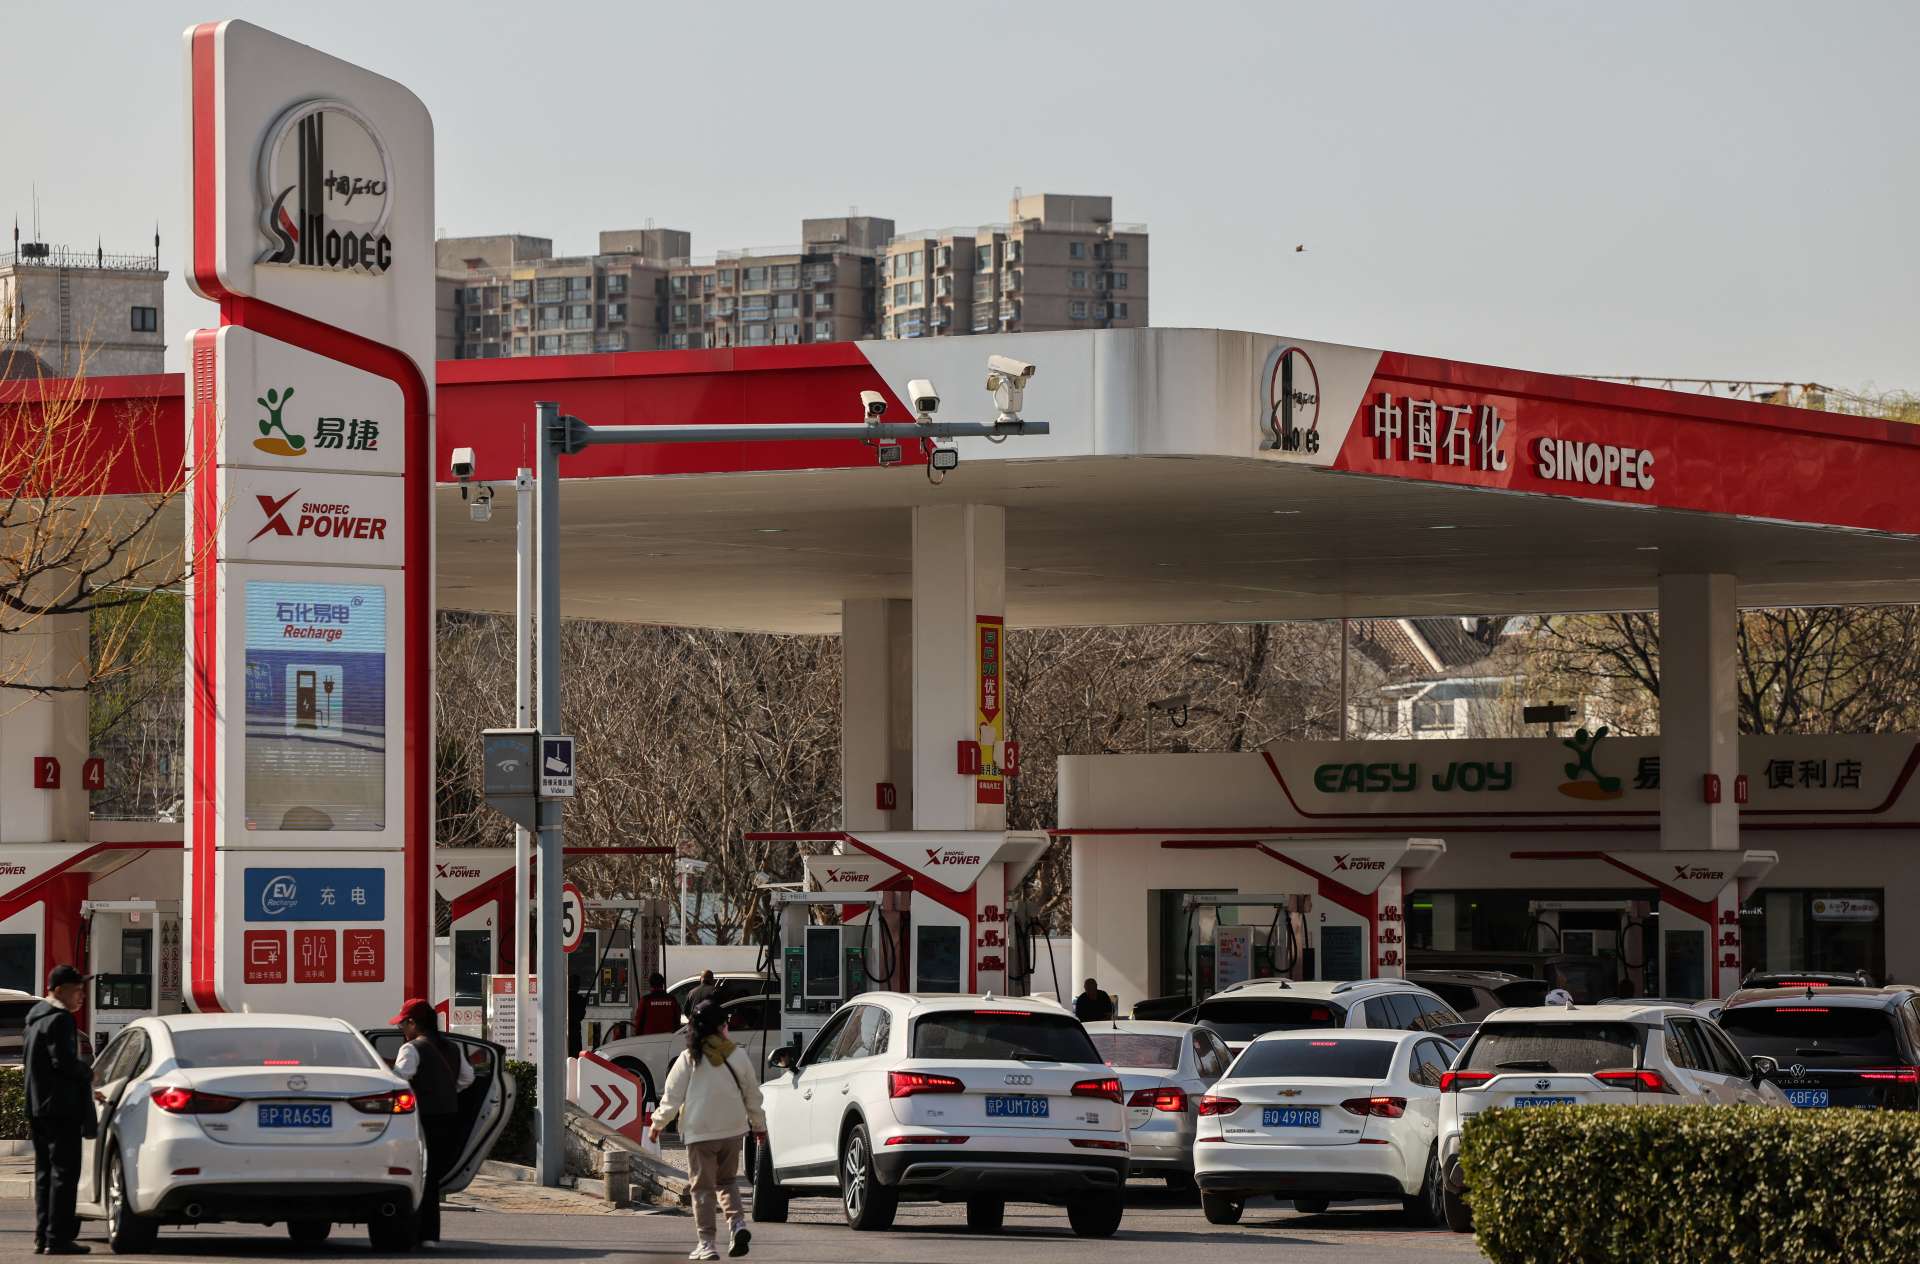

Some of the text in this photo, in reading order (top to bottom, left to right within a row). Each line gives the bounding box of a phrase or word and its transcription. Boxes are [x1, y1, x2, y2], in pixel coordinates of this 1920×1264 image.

[324, 169, 387, 207] 中国石化
[266, 182, 392, 273] SINOPEC
[313, 416, 380, 452] 易捷
[1373, 392, 1508, 474] 中国石化
[1537, 437, 1656, 492] SINOPEC
[301, 502, 350, 516] SINOPEC
[296, 515, 388, 541] POWER
[276, 601, 350, 624] 石化易电
[283, 624, 343, 642] Recharge
[970, 748, 976, 770] 1
[1006, 747, 1015, 769] 3
[46, 762, 55, 783] 2
[89, 763, 100, 785] 4
[1313, 761, 1513, 793] EASY JOY
[1763, 758, 1863, 790] 便利店
[883, 787, 894, 806] 10
[1712, 779, 1719, 799] 9
[1738, 781, 1747, 800] 11
[942, 855, 980, 865] POWER
[1349, 861, 1385, 870] POWER
[449, 869, 481, 878] POWER
[839, 874, 870, 882] POWER
[1689, 871, 1724, 880] POWER
[320, 886, 367, 906] 充电
[486, 917, 492, 927] 6
[562, 901, 575, 938] 5
[1320, 913, 1327, 922] 5
[1789, 1091, 1827, 1104] 6BF69
